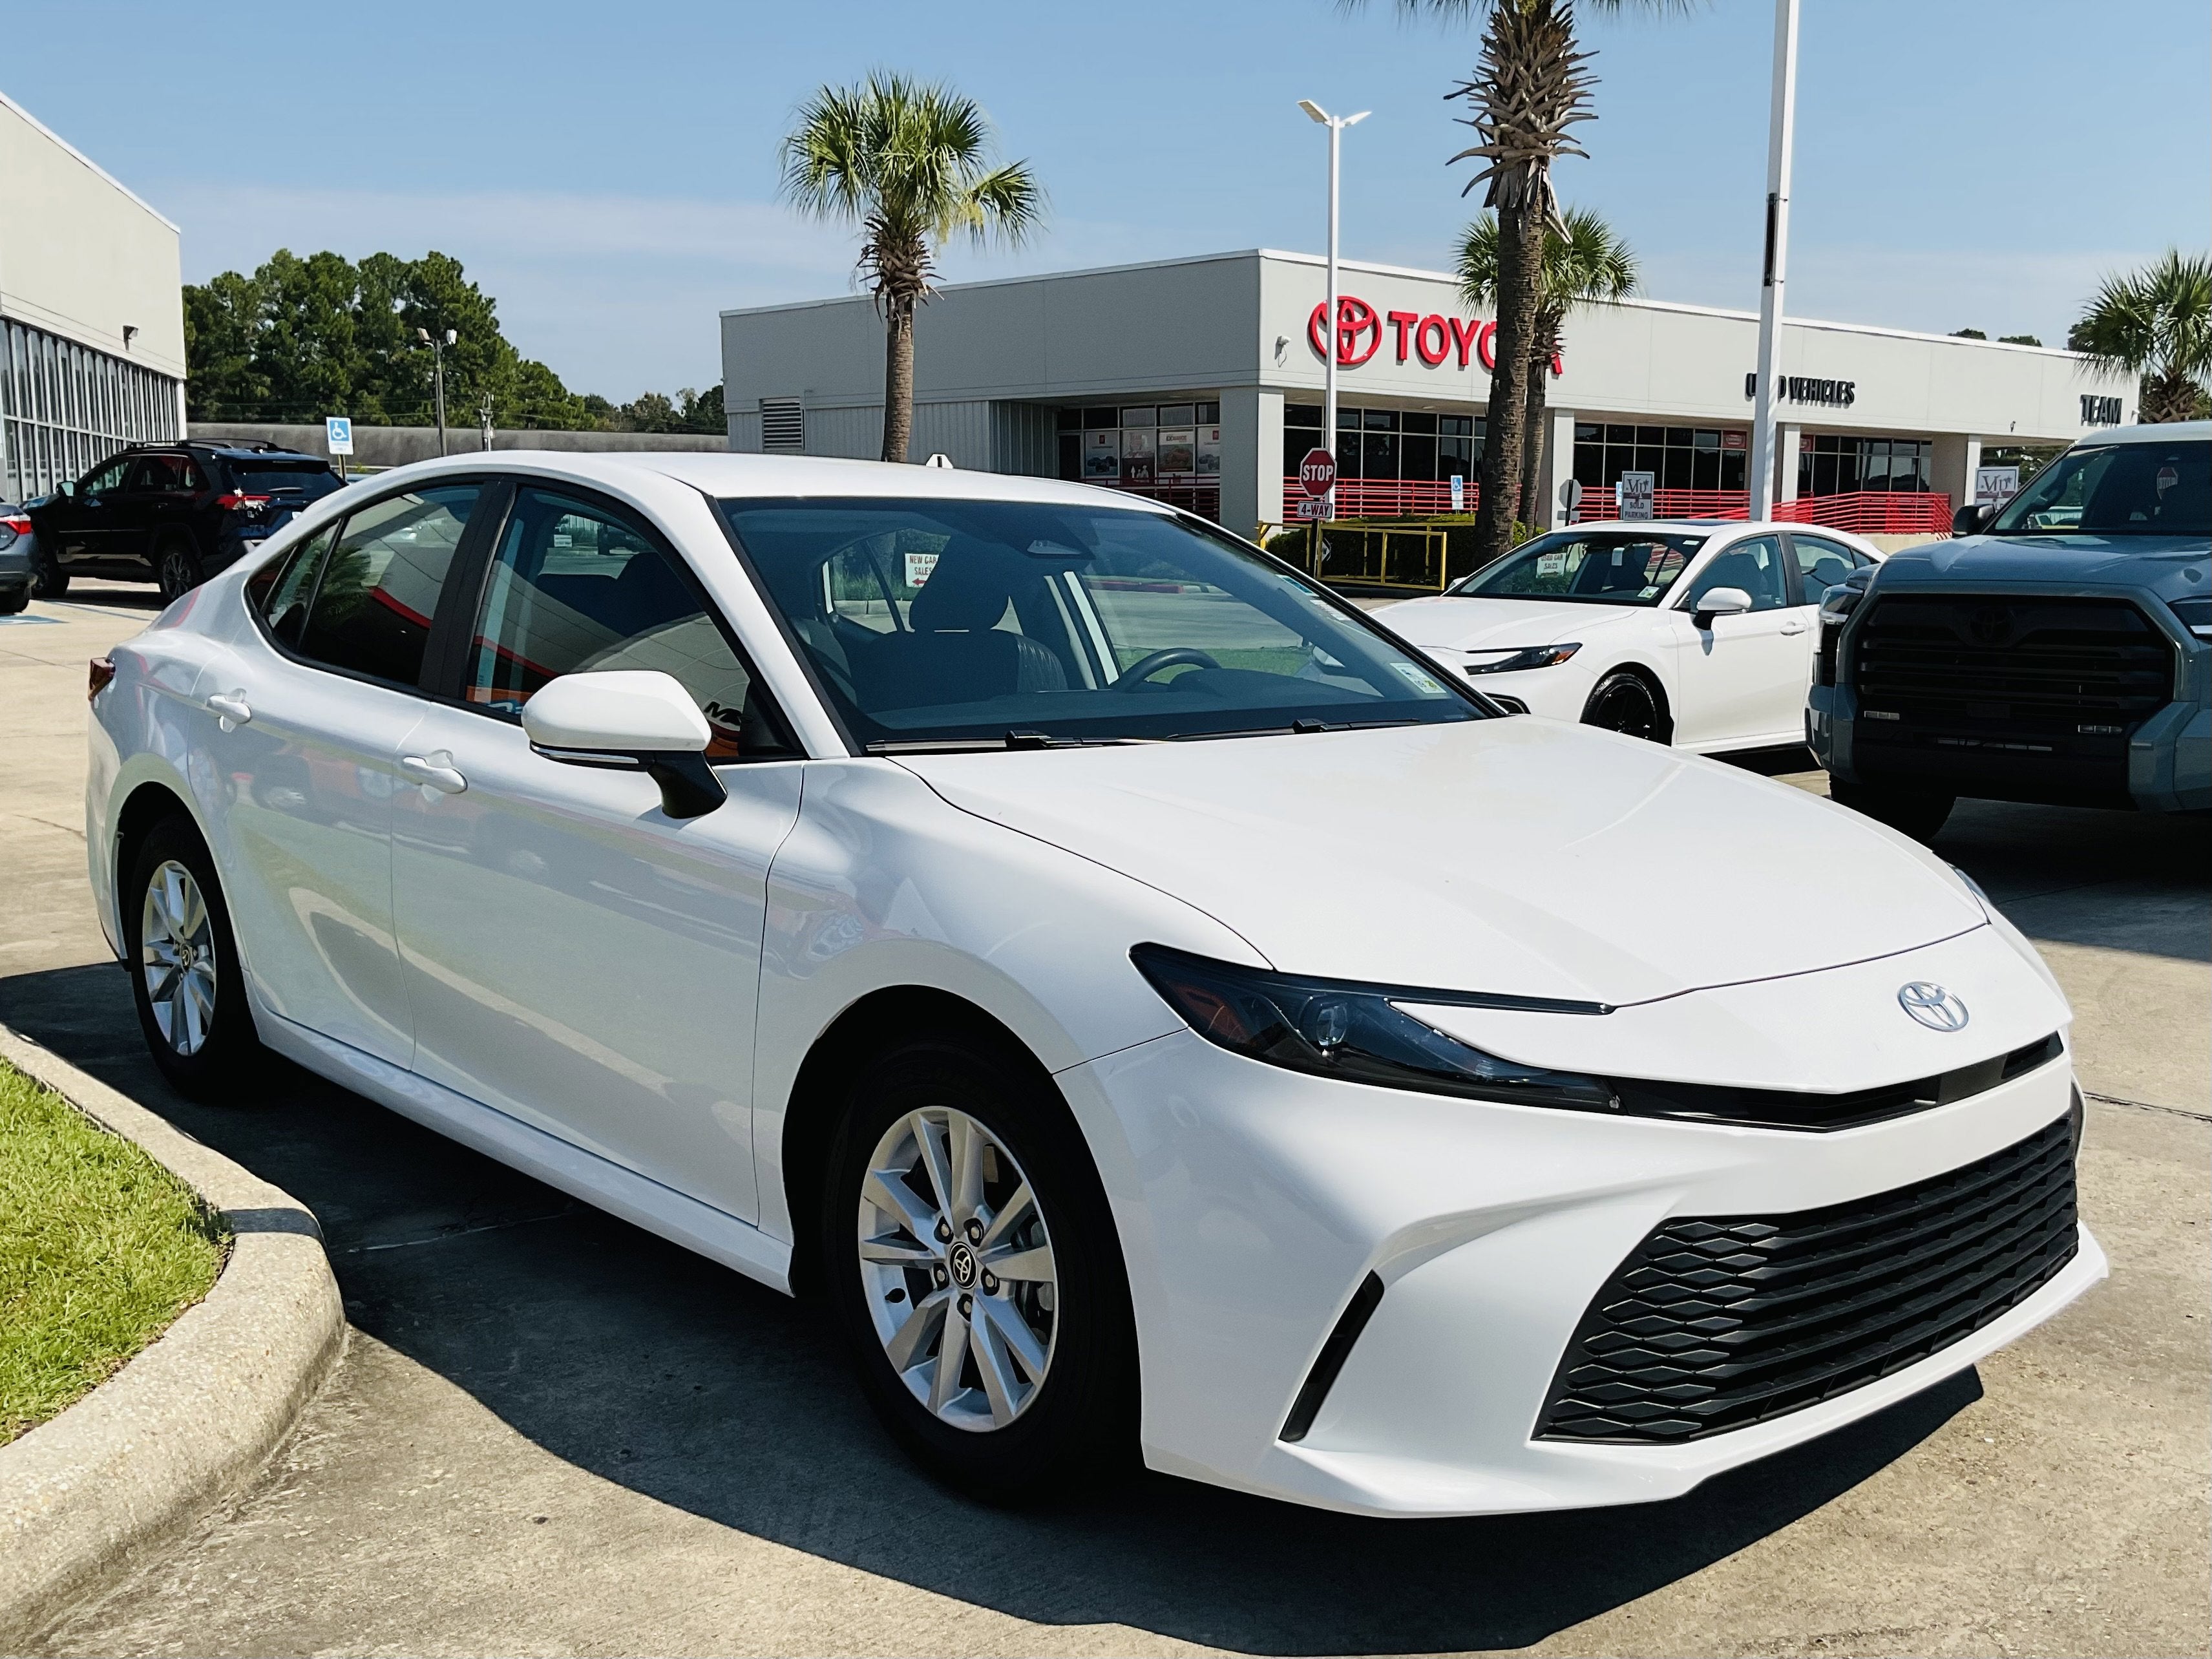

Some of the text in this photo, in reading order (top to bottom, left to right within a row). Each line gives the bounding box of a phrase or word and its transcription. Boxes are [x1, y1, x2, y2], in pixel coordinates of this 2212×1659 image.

[1745, 373, 1855, 404] UD VEHICLES
[2080, 395, 2122, 424] TEAM
[1303, 465, 1333, 481] STOP
[1301, 504, 1329, 516] 4-WAY
[909, 555, 936, 564] NEW CAR
[914, 567, 931, 575] SALES
